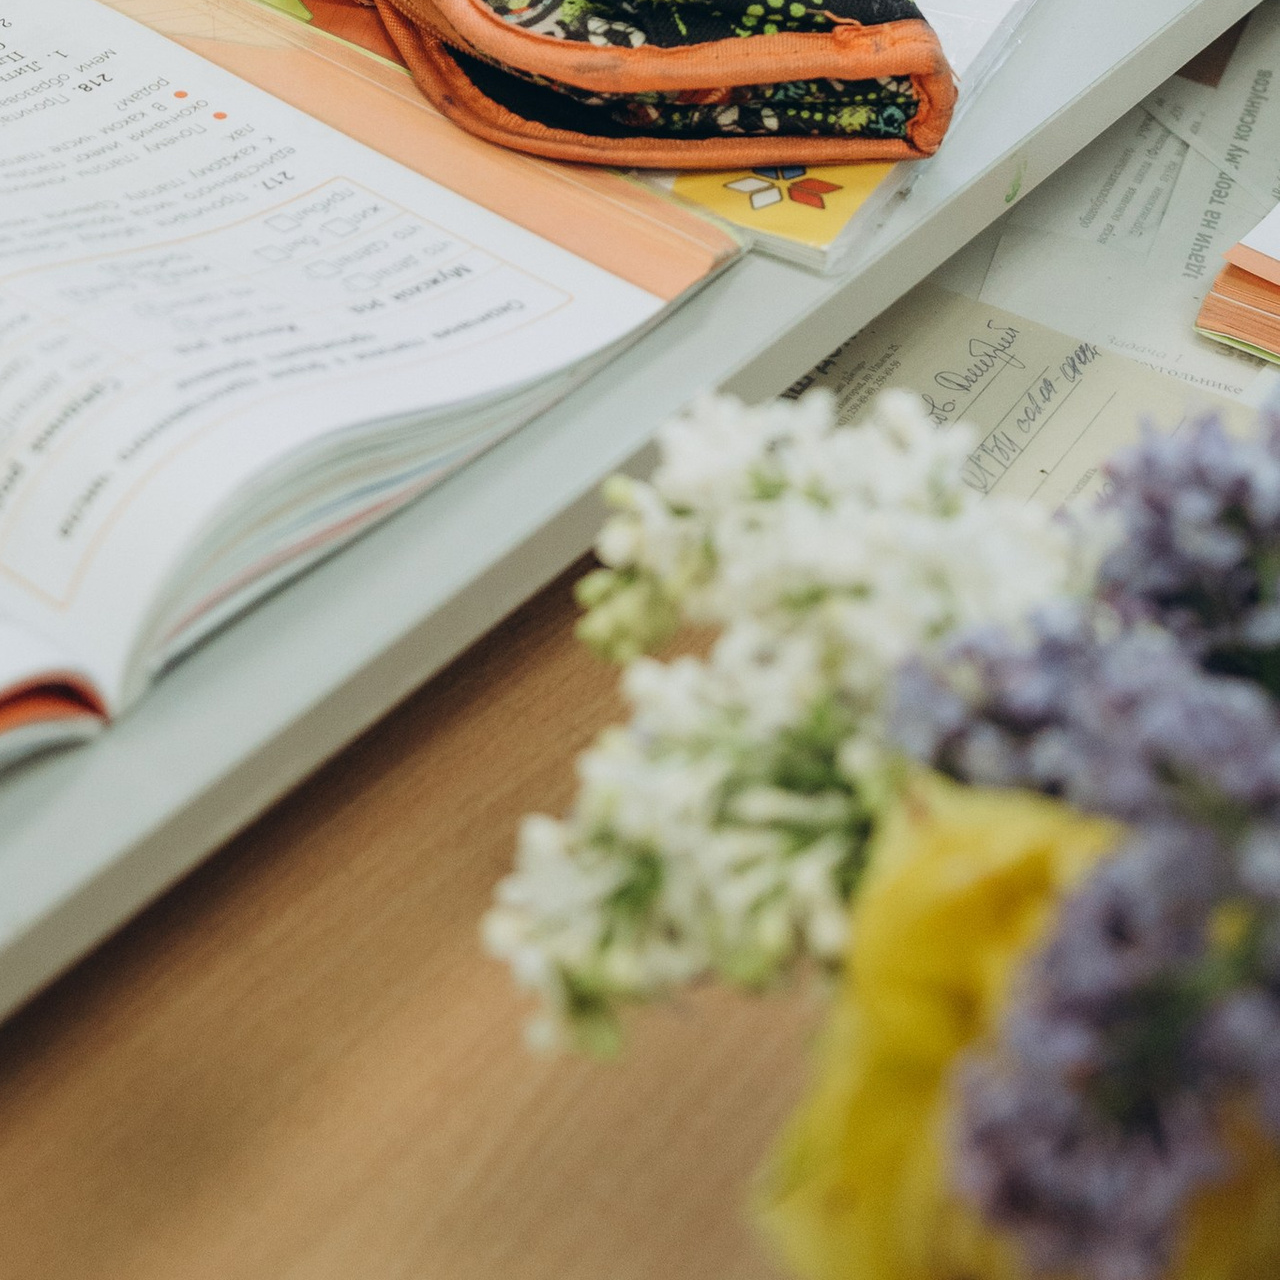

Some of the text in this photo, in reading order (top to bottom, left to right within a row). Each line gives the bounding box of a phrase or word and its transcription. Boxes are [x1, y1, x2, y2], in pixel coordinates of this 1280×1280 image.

[46, 49, 69, 59] 1.
[74, 48, 118, 74] мени
[77, 72, 114, 93] 218.
[113, 75, 171, 112] родам?
[98, 110, 149, 136] каком
[126, 99, 210, 142] окончания
[224, 122, 256, 143] лах.
[48, 134, 98, 154] числе
[142, 122, 208, 154] Почему
[1199, 209, 1223, 231] на
[1232, 68, 1274, 143] косинусов
[73, 140, 124, 164] имеют
[187, 143, 260, 180] каждому
[75, 152, 141, 179] глаголы
[182, 145, 297, 201] единственного
[261, 170, 295, 192] 217.
[1132, 358, 1243, 395] угольнике
